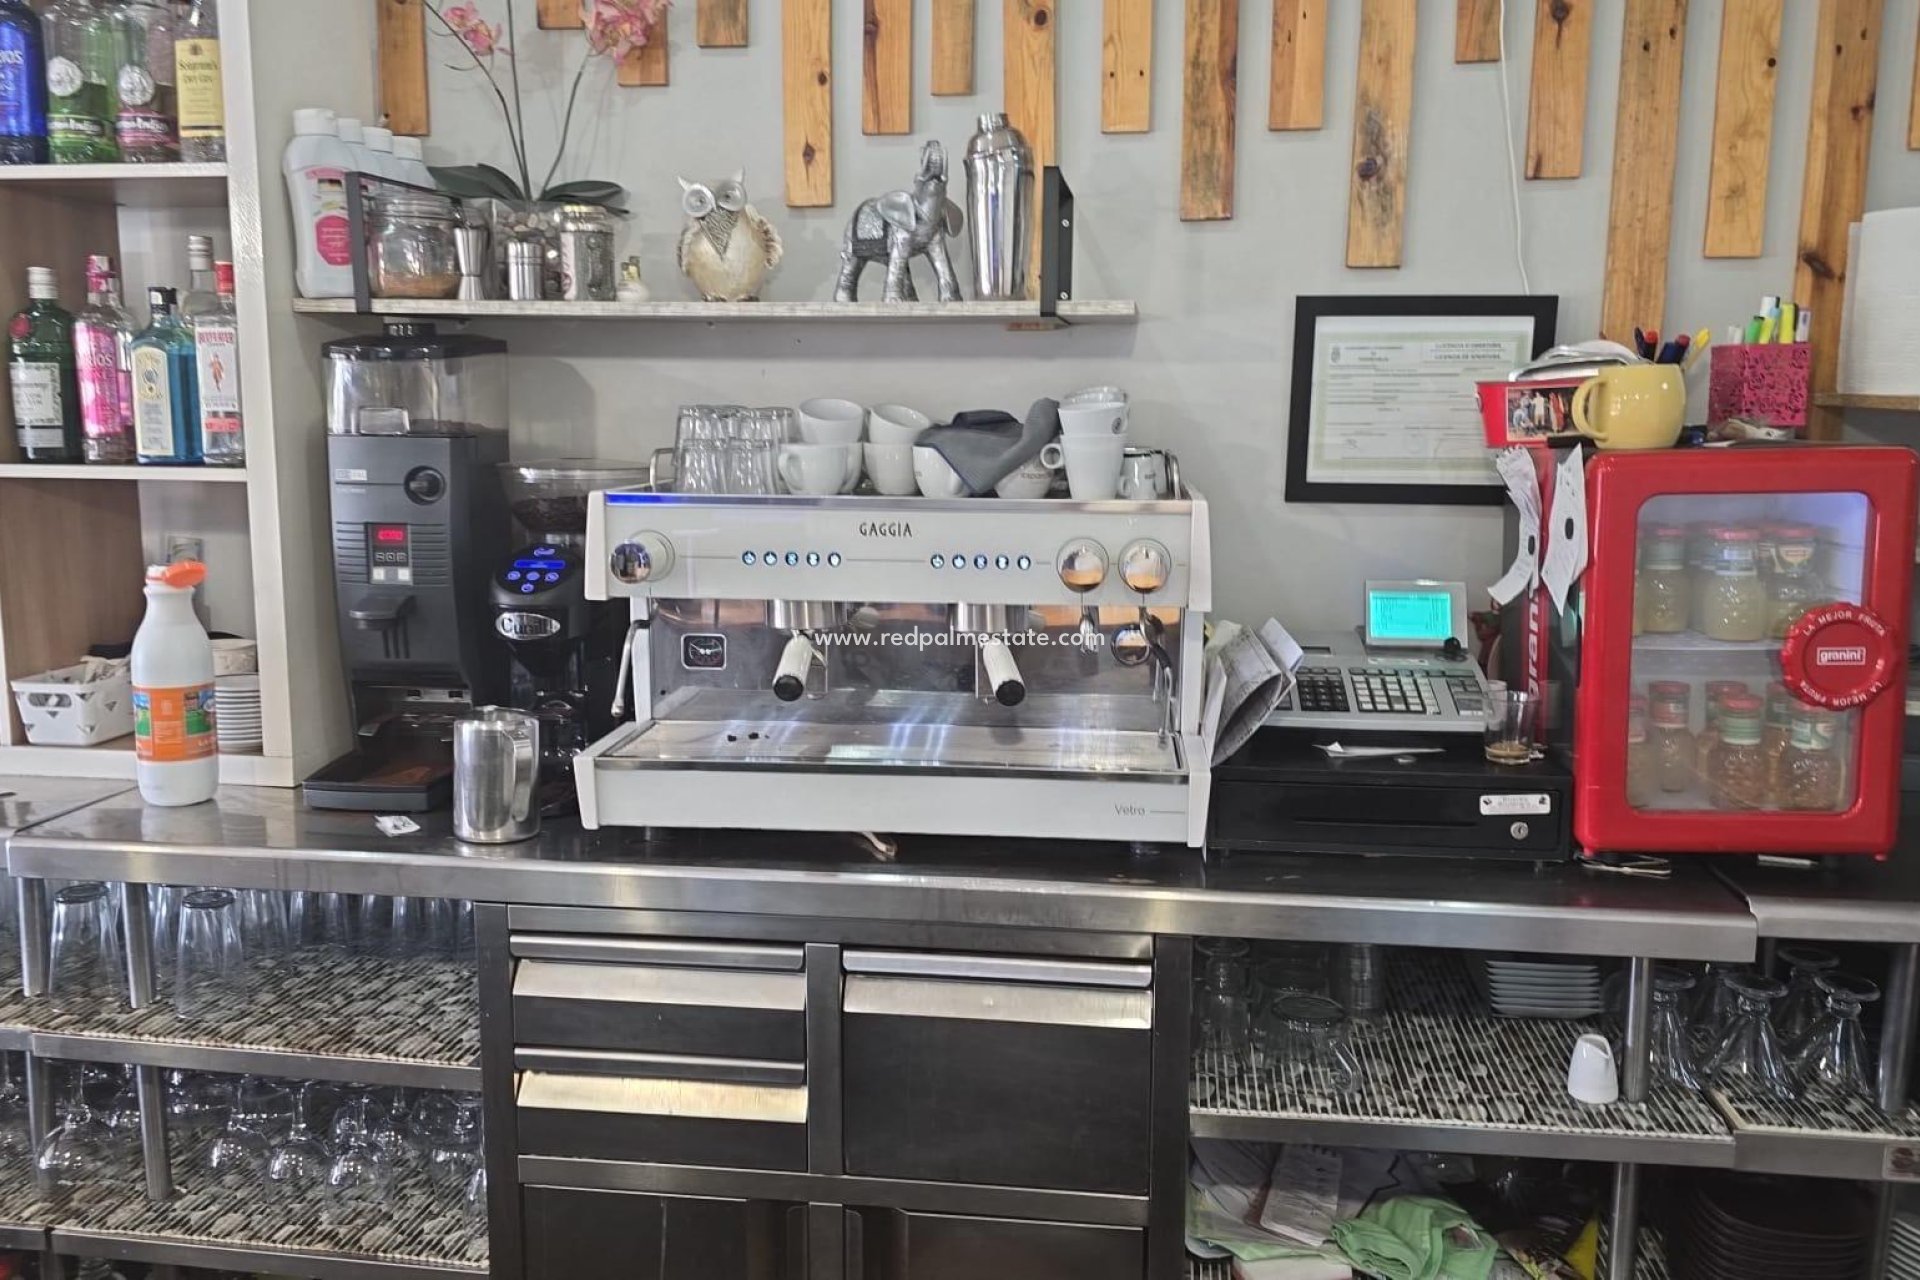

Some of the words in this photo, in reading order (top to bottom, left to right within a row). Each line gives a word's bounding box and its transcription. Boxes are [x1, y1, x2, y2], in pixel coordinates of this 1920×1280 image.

[858, 521, 913, 538] GAGGIA
[1817, 610, 1852, 624] MEJOR
[1819, 649, 1862, 664] granini
